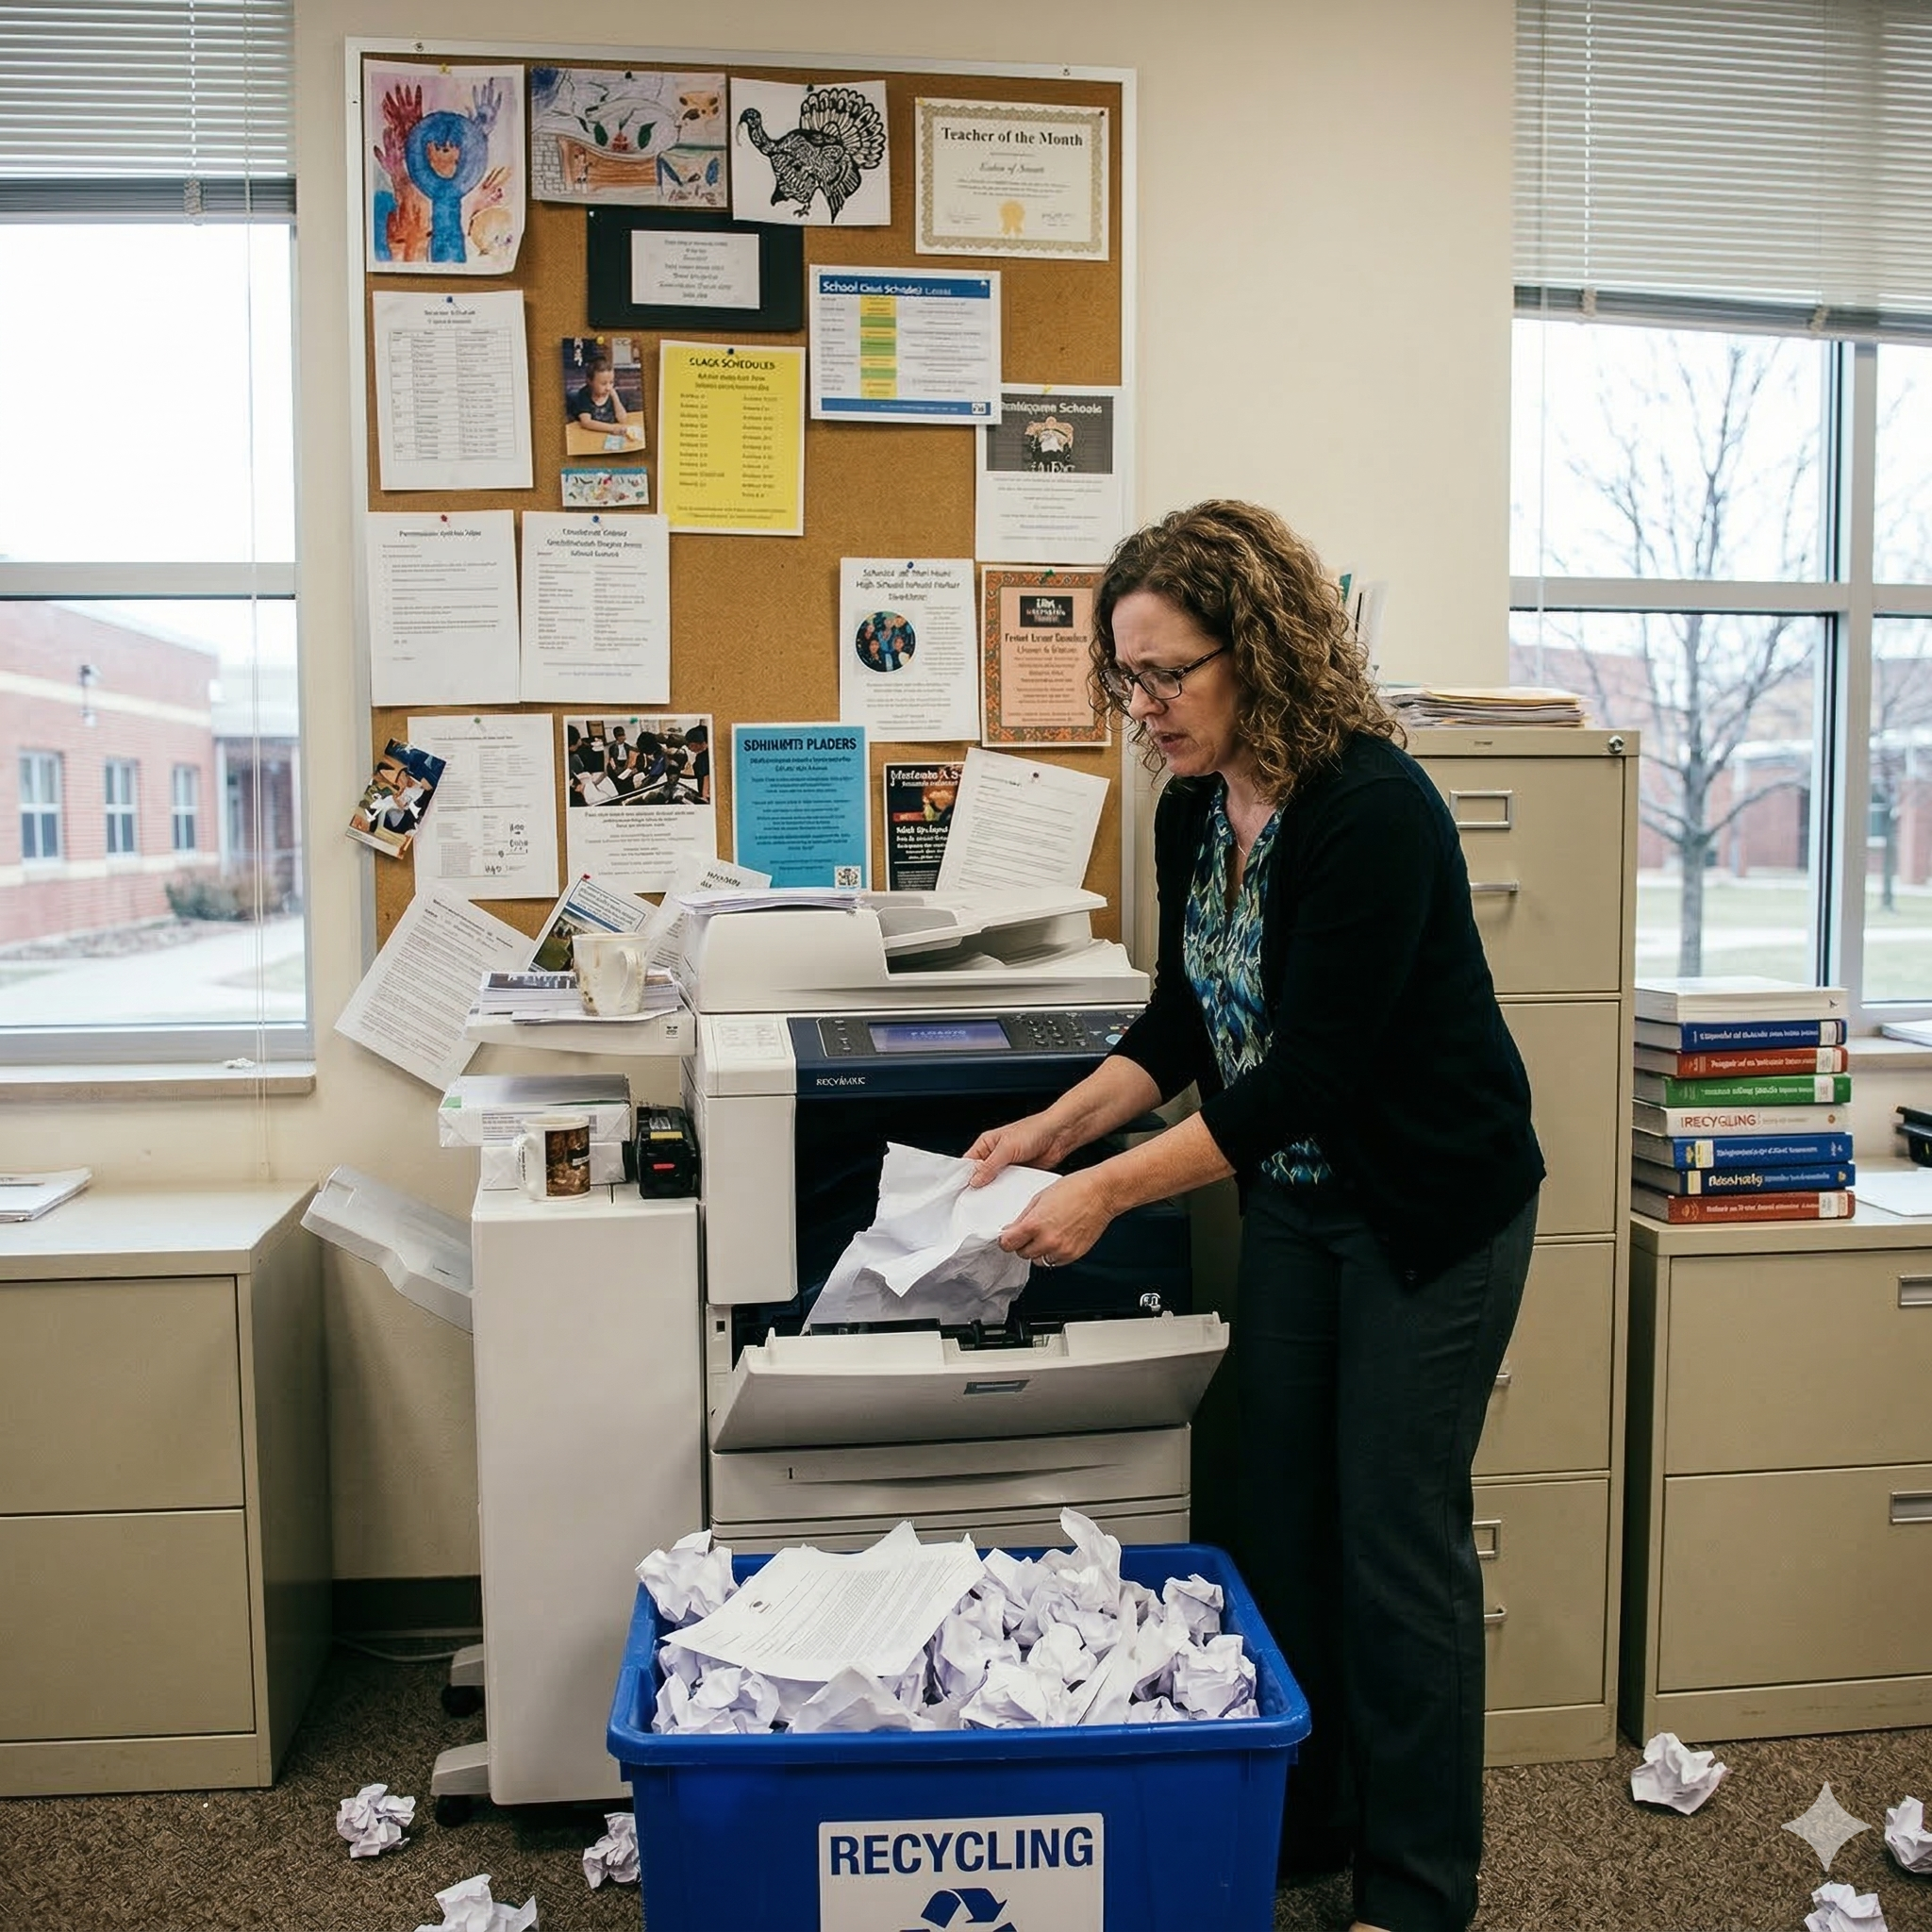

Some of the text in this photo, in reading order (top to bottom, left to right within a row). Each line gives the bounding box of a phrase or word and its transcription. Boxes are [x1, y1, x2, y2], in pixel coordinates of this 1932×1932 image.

[941, 127, 1083, 146] Teacher of the Month
[807, 738, 857, 750] PLADERS
[830, 1826, 1093, 1875] RECYCLING
